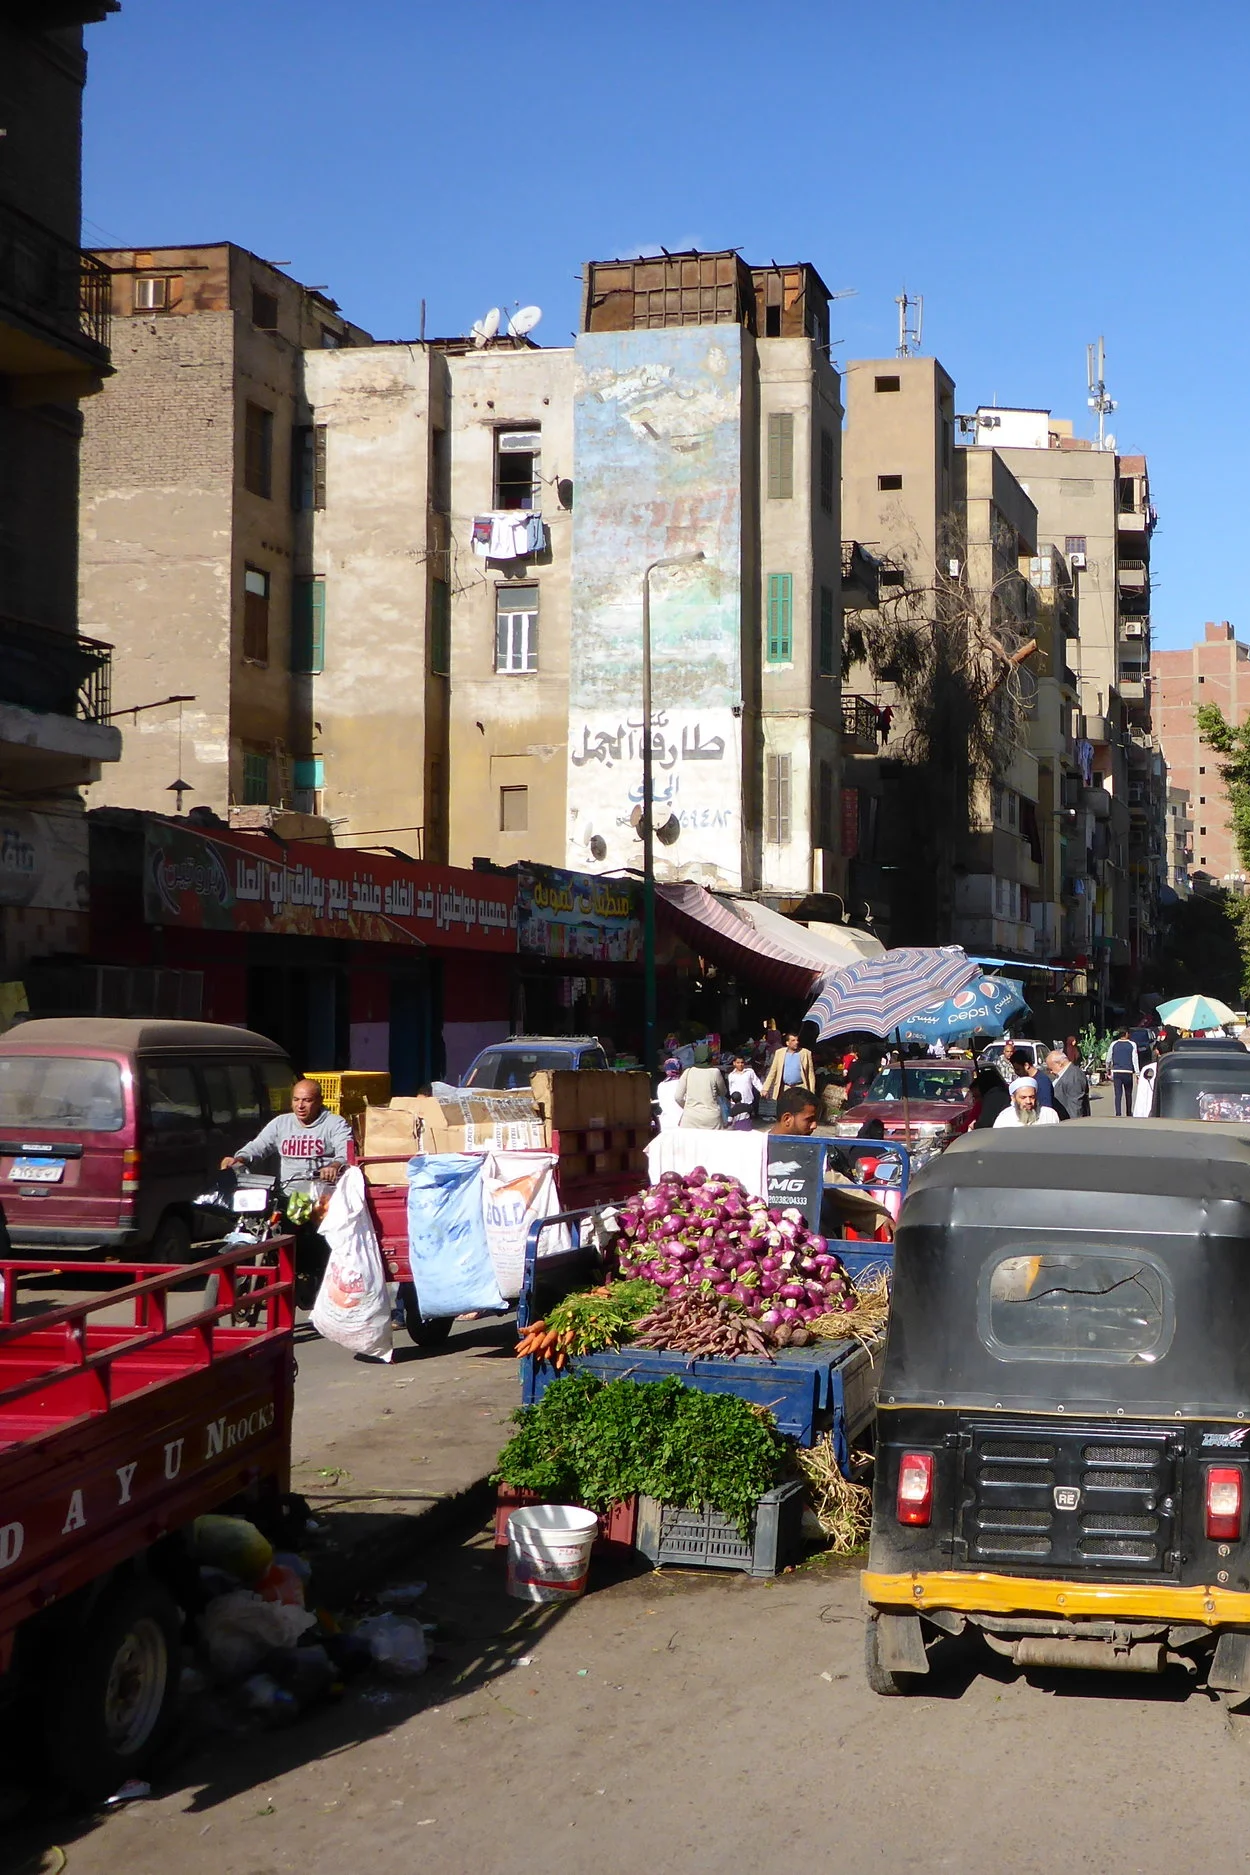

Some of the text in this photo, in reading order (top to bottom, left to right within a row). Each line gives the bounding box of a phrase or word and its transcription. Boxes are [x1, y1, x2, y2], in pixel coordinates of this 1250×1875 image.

[571, 723, 726, 770] طارق الجمل
[948, 1005, 989, 1025] pepsi
[281, 1139, 325, 1156] CHIEFS
[767, 1178, 806, 1192] MG
[1058, 1493, 1076, 1505] RE
